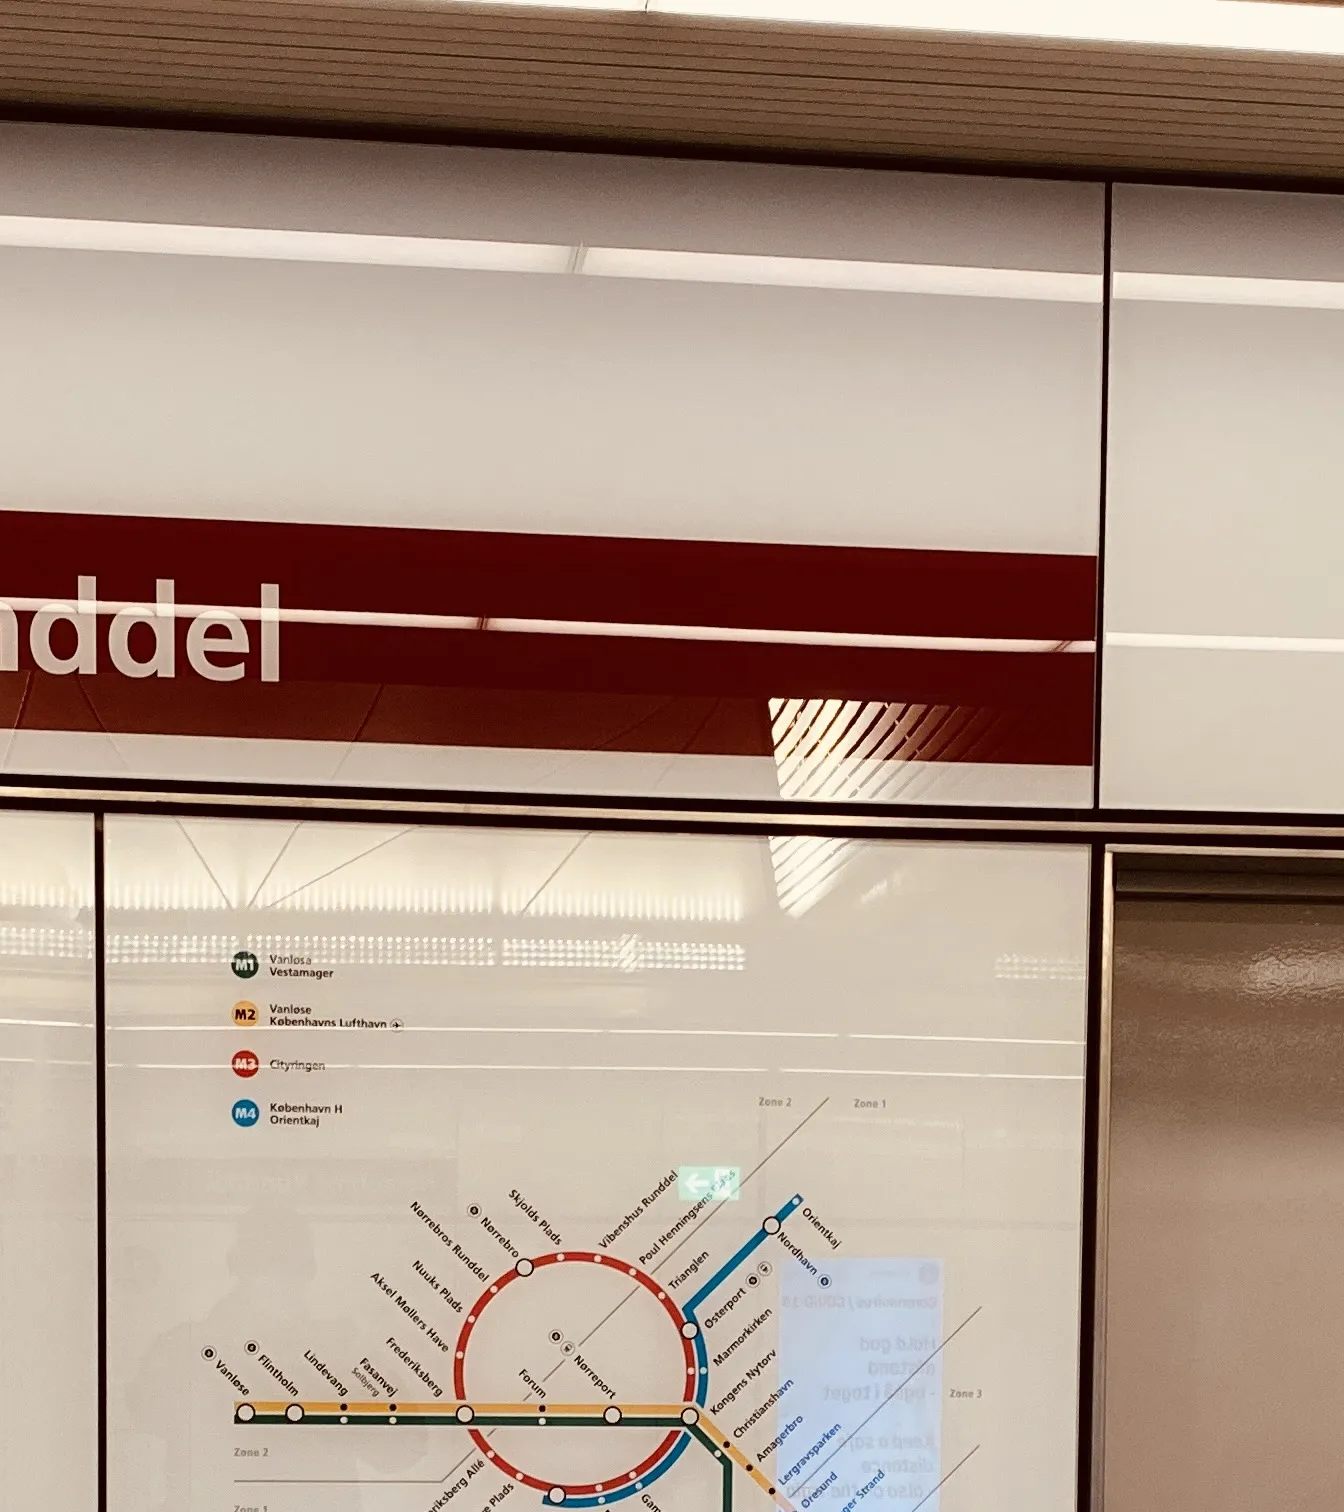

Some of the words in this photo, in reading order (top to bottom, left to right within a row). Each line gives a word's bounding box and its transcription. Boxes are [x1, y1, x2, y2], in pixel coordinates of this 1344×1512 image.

[235, 959, 255, 971] M1
[270, 968, 334, 980] Vestamager
[235, 1009, 256, 1021] M2
[270, 1004, 312, 1015] Vanløse
[270, 1017, 336, 1027] Københavns
[340, 1018, 387, 1029] Lufthavn
[235, 1058, 256, 1070] M3
[270, 1059, 325, 1072] Cityringen
[235, 1107, 256, 1119] M4
[270, 1103, 332, 1114] København
[334, 1104, 343, 1114] H
[270, 1115, 320, 1128] Orientkaj
[759, 1097, 783, 1107] Zone
[854, 1098, 878, 1108] Zone
[509, 1189, 540, 1223] Skjolds
[538, 1219, 563, 1246] Plads
[598, 1205, 644, 1249] Vibenshus
[641, 1170, 679, 1210] Runddel
[638, 1244, 661, 1266] Poul
[658, 1190, 713, 1247] Henningsens
[802, 1207, 843, 1250] Orientkaj
[410, 1201, 453, 1247] Nørrebros
[451, 1244, 490, 1283] Runddel
[480, 1217, 519, 1259] Nørrebro
[777, 1231, 818, 1276] Nordhavn
[412, 1260, 440, 1289] Nuuks
[439, 1287, 464, 1314] Plads
[668, 1251, 709, 1291] Trianglen
[370, 1272, 397, 1299] Aksel
[394, 1296, 428, 1332] Møllers
[425, 1328, 450, 1353] Have
[704, 1287, 746, 1329] Østerport
[713, 1308, 773, 1366] Marmorkirken
[215, 1359, 250, 1396] Vanløse
[257, 1354, 300, 1397] Flintholm
[303, 1349, 349, 1397] Lindevang
[351, 1367, 380, 1398] Solbjerg
[359, 1357, 399, 1398] Fasanvej
[386, 1337, 443, 1398] Frederiksberg
[518, 1368, 547, 1399] Forum
[574, 1355, 617, 1400] Nørreport
[710, 1378, 748, 1416] Kongens
[746, 1349, 777, 1379] Nytorv
[733, 1378, 795, 1439] Christianshavn
[949, 1389, 974, 1399] Zone
[233, 1447, 257, 1457] Zone
[756, 1414, 804, 1463] Amagerbro
[777, 1422, 843, 1486] Lergravsparken
[466, 1458, 485, 1480] Allé
[856, 1469, 886, 1500] Strand
[488, 1482, 515, 1507] Plads
[801, 1471, 839, 1509] Øresund
